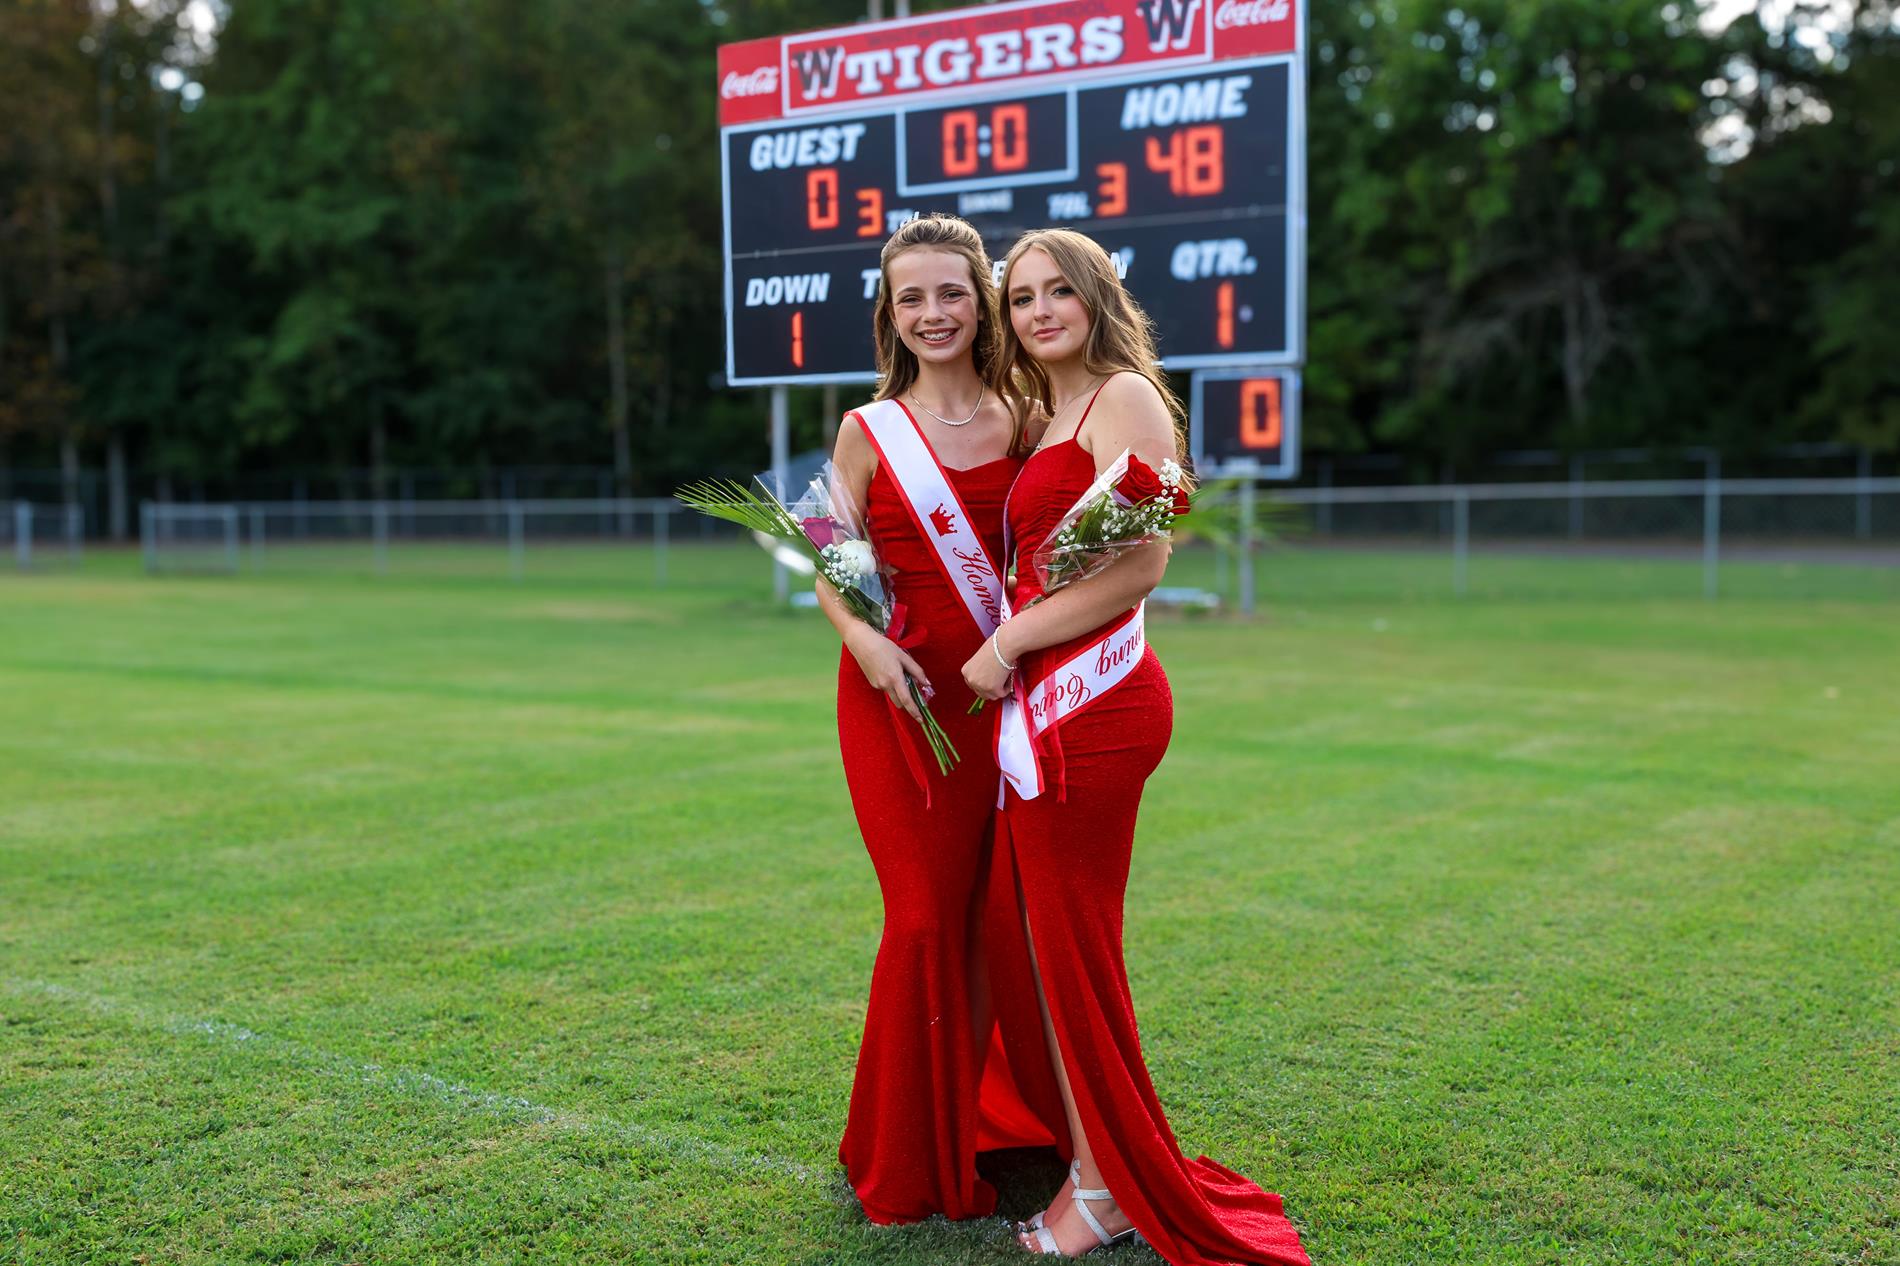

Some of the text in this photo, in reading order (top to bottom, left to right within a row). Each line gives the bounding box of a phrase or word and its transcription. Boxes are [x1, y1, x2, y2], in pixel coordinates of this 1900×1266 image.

[845, 15, 1124, 95] TIGERS
[1120, 75, 1252, 130] HOME
[750, 123, 866, 171] GUEST
[943, 105, 1027, 176] 0:0
[1145, 124, 1223, 196] 48
[807, 168, 839, 231] 0
[855, 188, 883, 237] 3
[1096, 162, 1127, 218] 3
[1170, 238, 1258, 281] QTR.
[745, 273, 831, 307] DOWN
[1217, 281, 1234, 348] 1
[791, 311, 804, 368] 1
[1240, 377, 1282, 448] 0
[952, 546, 1002, 629] Homec
[1029, 672, 1091, 717] Cour
